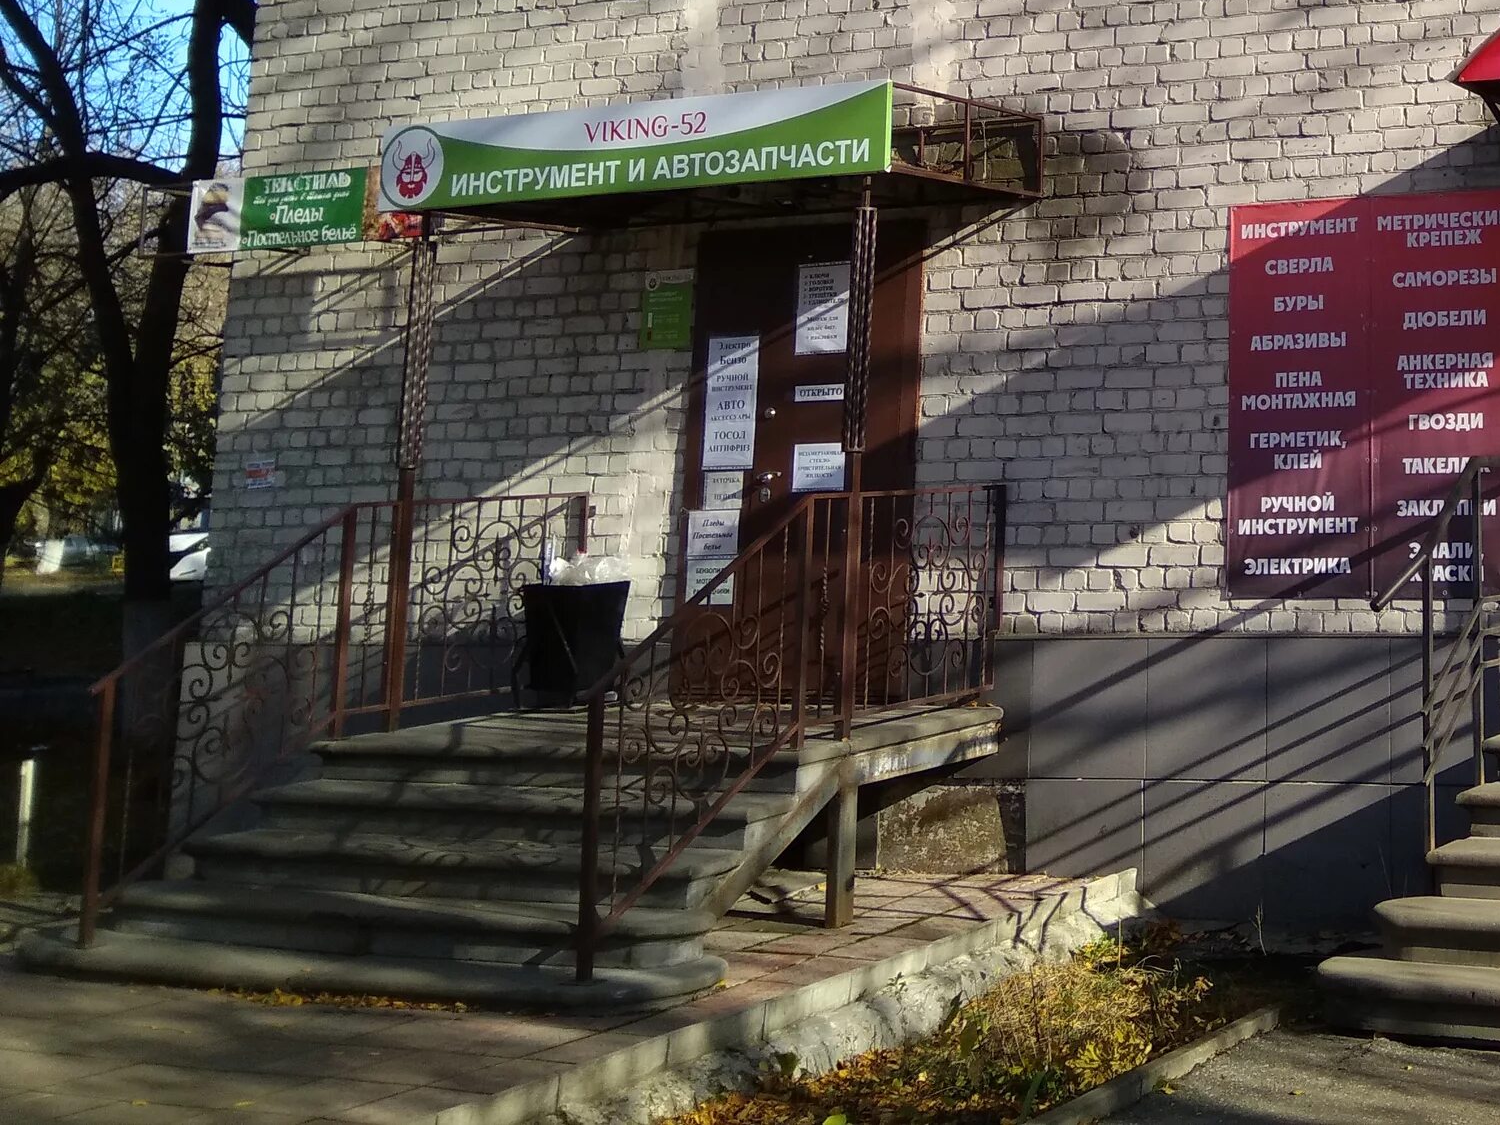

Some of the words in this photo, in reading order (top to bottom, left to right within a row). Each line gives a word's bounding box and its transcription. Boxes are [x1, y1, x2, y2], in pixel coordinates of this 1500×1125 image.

[584, 111, 707, 144] VIKING-52
[451, 160, 621, 197] ИНСТРУМЕНТ
[628, 158, 646, 181] И
[652, 139, 870, 181] АВТОЗАПЧАСТИ
[263, 172, 352, 194] ТЕКСТИЛЬ
[1241, 217, 1358, 239] ИНСТРУМЕНТ
[247, 230, 318, 247] Постельное
[1407, 229, 1482, 248] КРЕПЕЖ
[1265, 257, 1334, 275] СВЕРЛА
[1392, 268, 1497, 288] САМОРЕЗЫ
[1274, 295, 1324, 312] БУРЫ
[1403, 309, 1487, 330] ДЮБЕЛИ
[1251, 332, 1347, 351] АБРАЗИВЫ
[1397, 352, 1494, 371] АНКЕРНАЯ
[716, 373, 749, 382] РУЧНОЙ
[1275, 371, 1323, 388] ПЕНА
[1404, 371, 1489, 389] ТЕХНИКА
[800, 388, 843, 397] ОТКРЫТО
[1241, 391, 1356, 411] МОНТАЖНАЯ
[717, 400, 745, 410] АВТО
[1408, 412, 1484, 432] ГВОЗДИ
[714, 430, 746, 440] ТОСОЛ
[1250, 430, 1347, 449] ГЕРМЕТИК,
[708, 444, 751, 452] АНТИФРИЗ
[1274, 449, 1322, 470] КЛЕЙ
[1261, 491, 1335, 513] РУЧНОЙ
[1238, 517, 1358, 535] ИНСТРУМЕНТ
[1244, 557, 1351, 575] ЭЛЕКТРИКА
